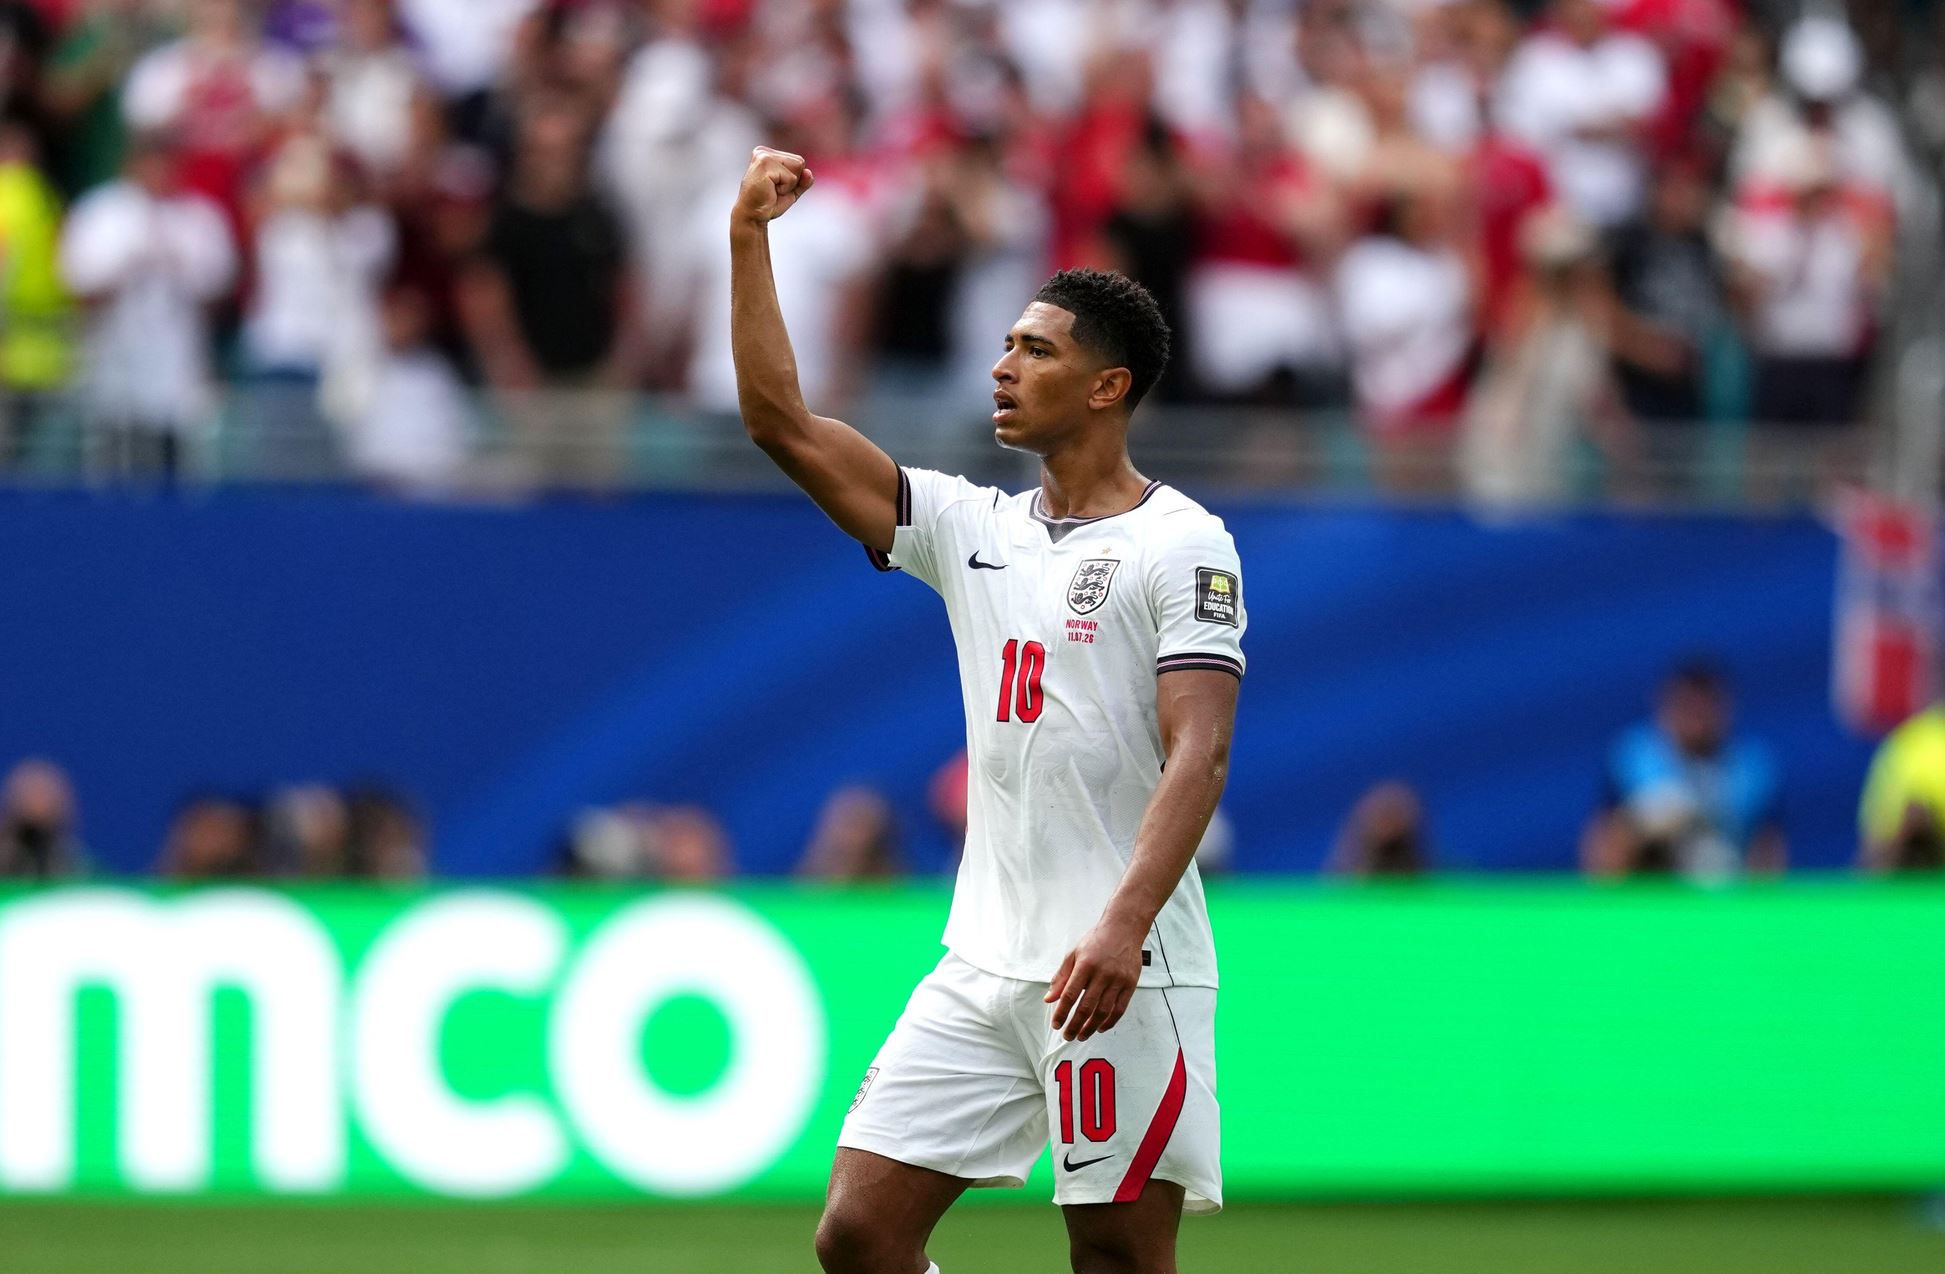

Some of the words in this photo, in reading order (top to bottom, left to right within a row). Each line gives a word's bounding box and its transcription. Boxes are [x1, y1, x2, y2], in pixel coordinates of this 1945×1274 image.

[1203, 601, 1234, 616] EDUCATION
[1066, 619, 1098, 631] NORWAY
[1068, 632, 1094, 643] 11.07.26
[997, 639, 1045, 723] 10
[1055, 1058, 1116, 1144] 10
